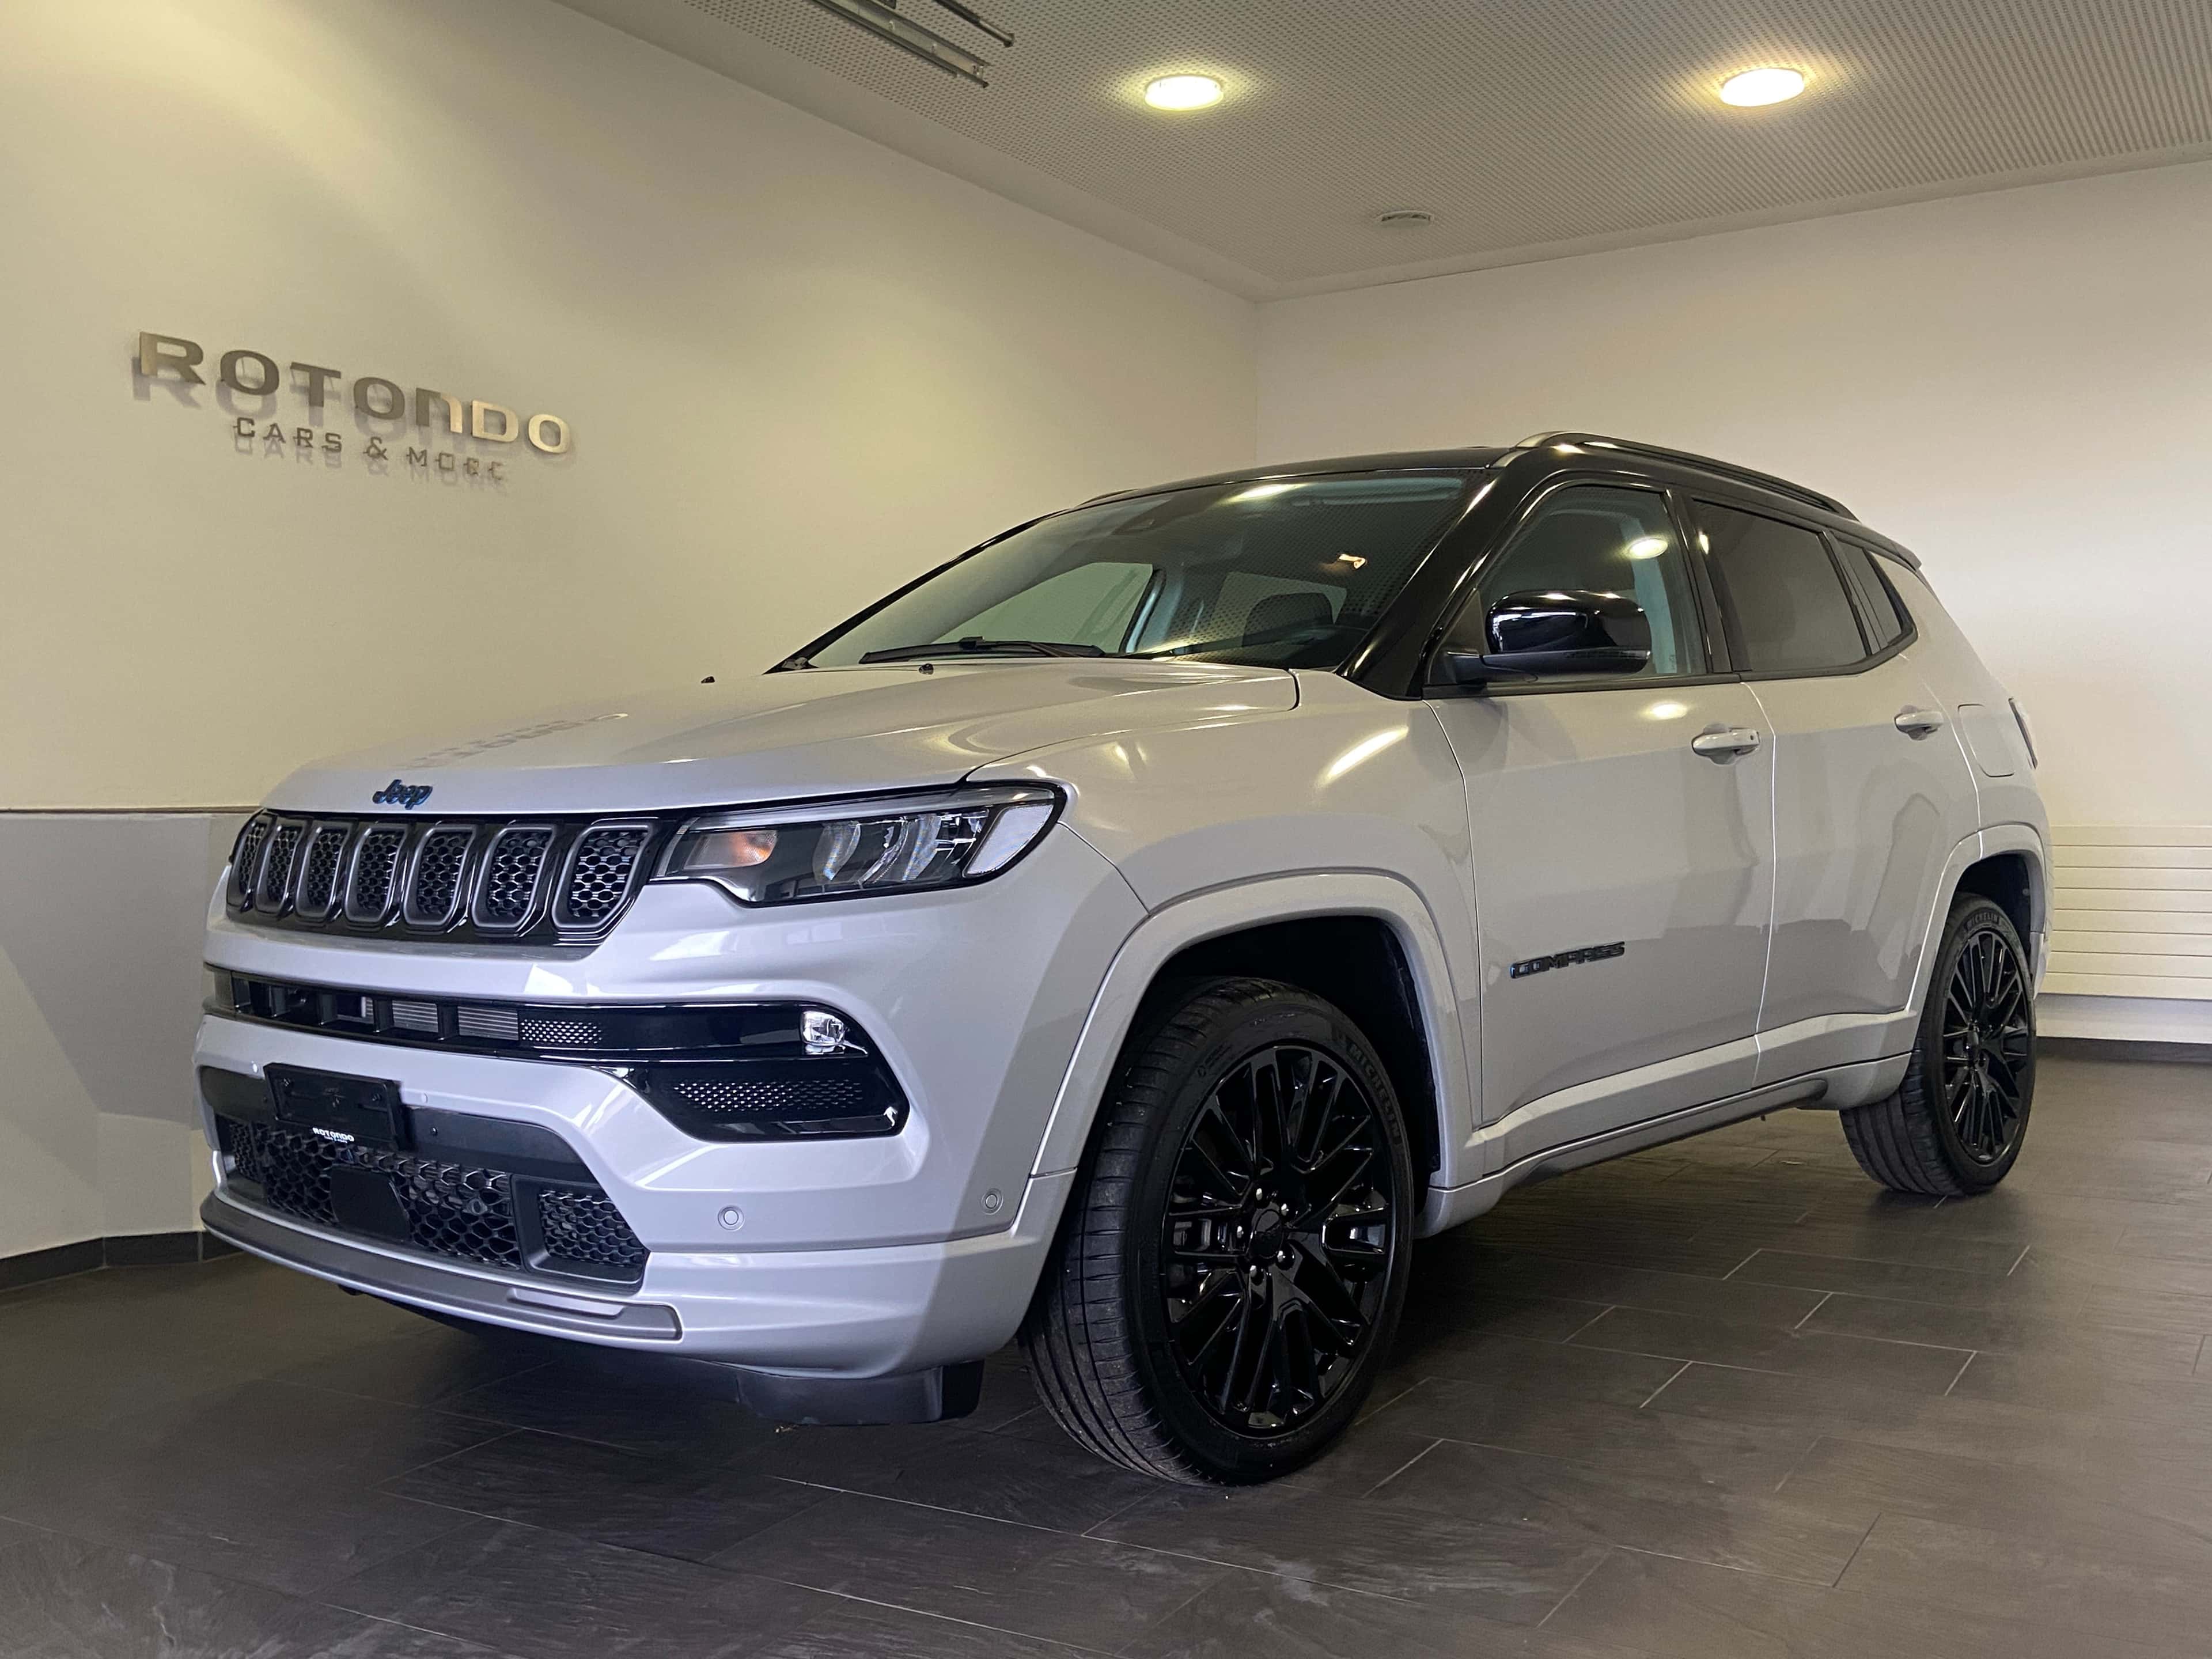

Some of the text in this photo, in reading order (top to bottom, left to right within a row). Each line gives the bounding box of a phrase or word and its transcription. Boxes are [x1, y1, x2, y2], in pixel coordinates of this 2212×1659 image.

[235, 417, 343, 452] CARS
[364, 436, 388, 460] &
[372, 779, 433, 810] Jeep
[1509, 941, 1625, 979] COMPASS
[1347, 1042, 1400, 1139] MICHELIN
